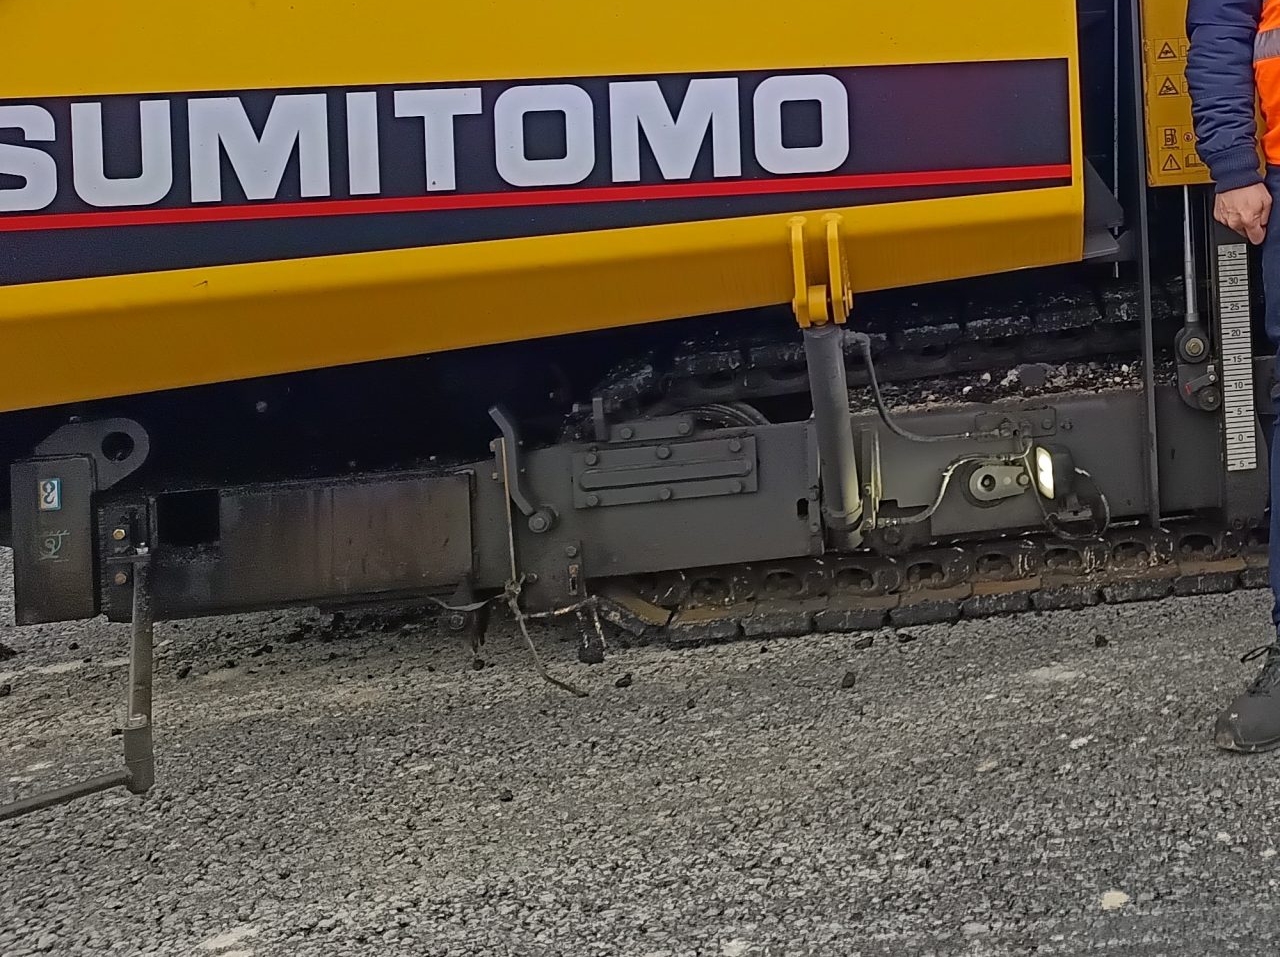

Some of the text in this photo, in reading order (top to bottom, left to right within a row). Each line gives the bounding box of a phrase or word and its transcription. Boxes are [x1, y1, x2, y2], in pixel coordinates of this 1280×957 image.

[0, 74, 850, 212] SUMITOMO
[1226, 250, 1238, 259] 35
[1228, 276, 1239, 285] 30
[1229, 303, 1240, 311] 25
[1231, 328, 1242, 337] 20
[1232, 355, 1242, 363] 15
[1234, 381, 1244, 389] 10
[1237, 407, 1243, 416] 5
[1238, 433, 1244, 442] 0
[1239, 459, 1245, 468] 5
